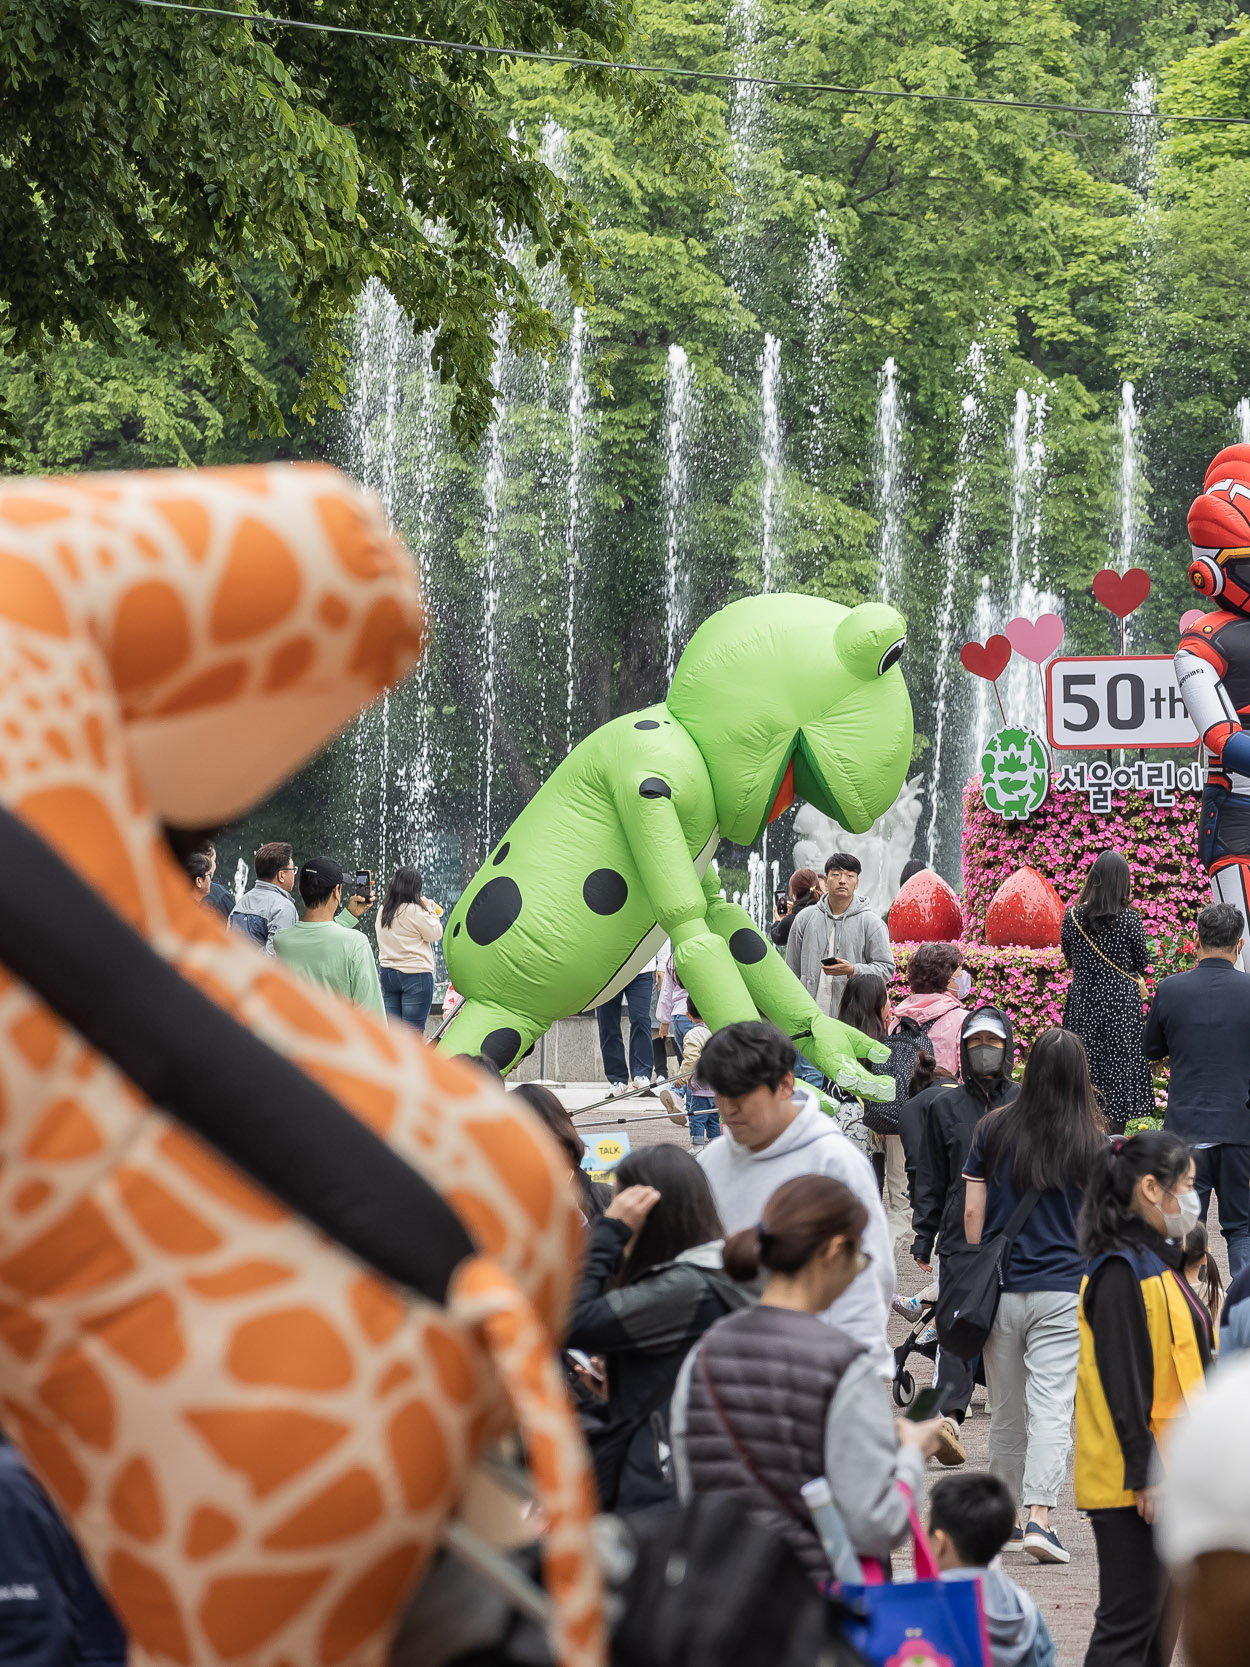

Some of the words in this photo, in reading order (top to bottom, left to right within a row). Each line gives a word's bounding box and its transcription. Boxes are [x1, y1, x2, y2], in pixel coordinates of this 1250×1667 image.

[1062, 673, 1189, 732] 50th
[1055, 760, 1204, 813] 서울어린이
[598, 1146, 621, 1155] TALK
